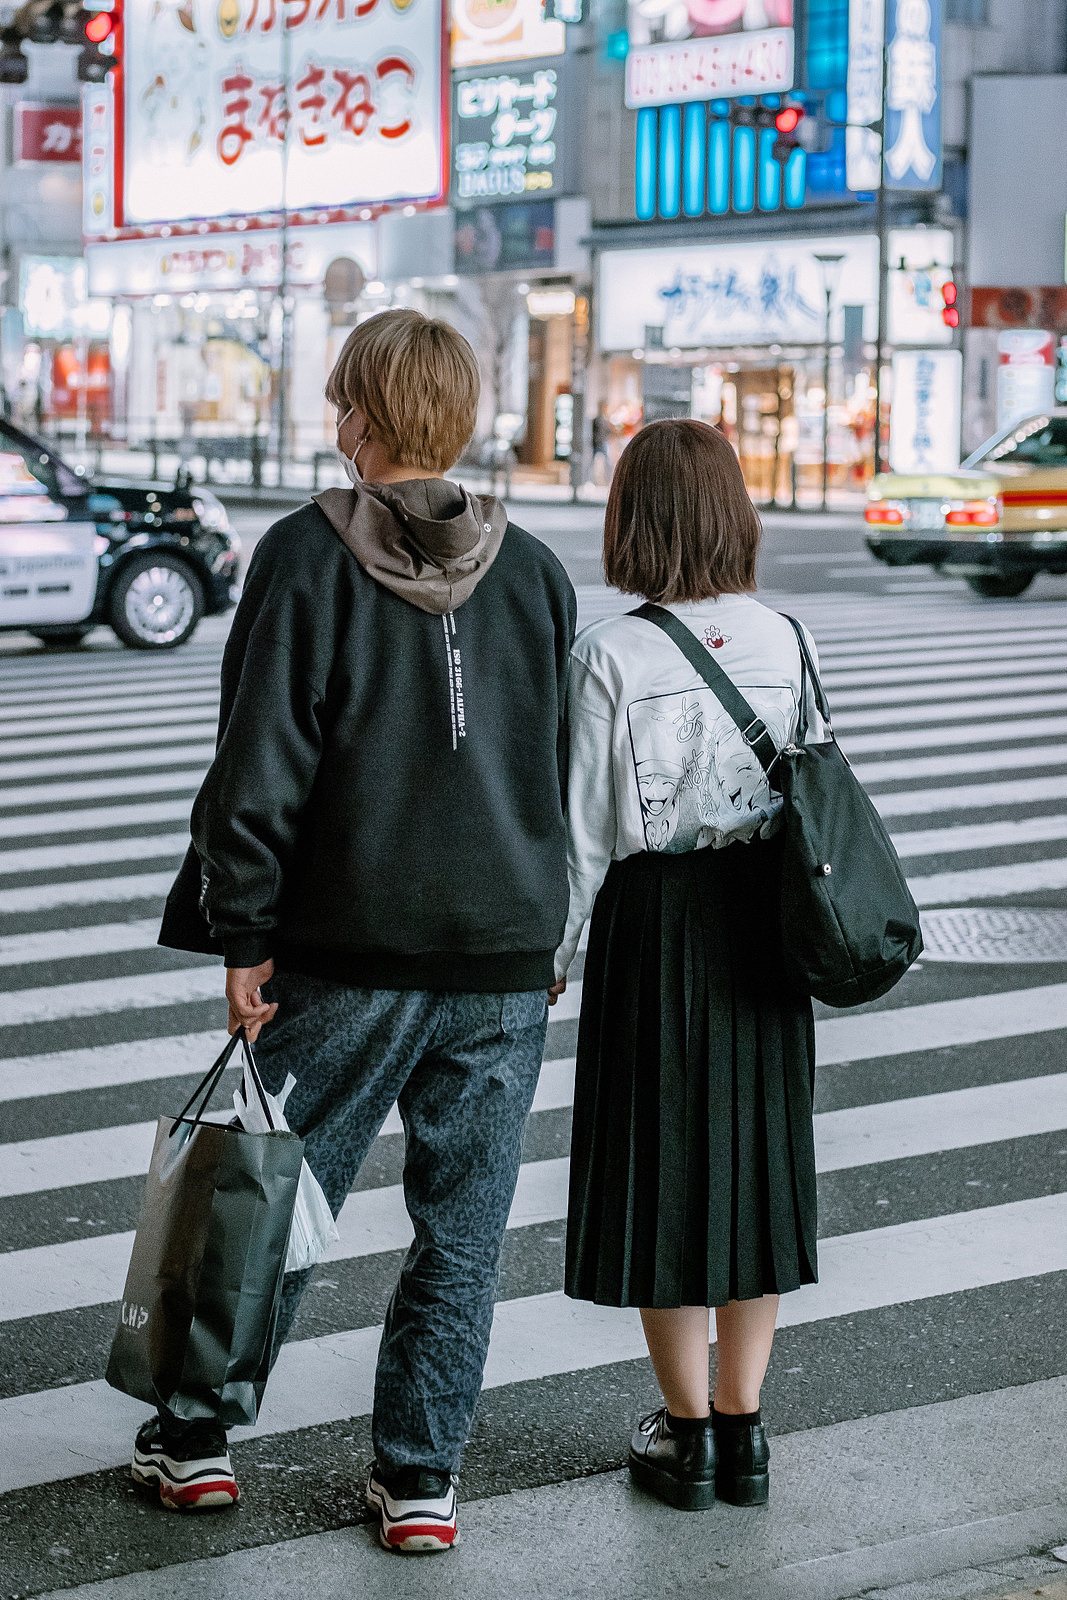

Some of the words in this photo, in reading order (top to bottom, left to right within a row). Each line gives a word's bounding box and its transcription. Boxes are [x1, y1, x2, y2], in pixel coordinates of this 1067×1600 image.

[217, 57, 415, 166] まねきねこ
[453, 649, 461, 665] ISO
